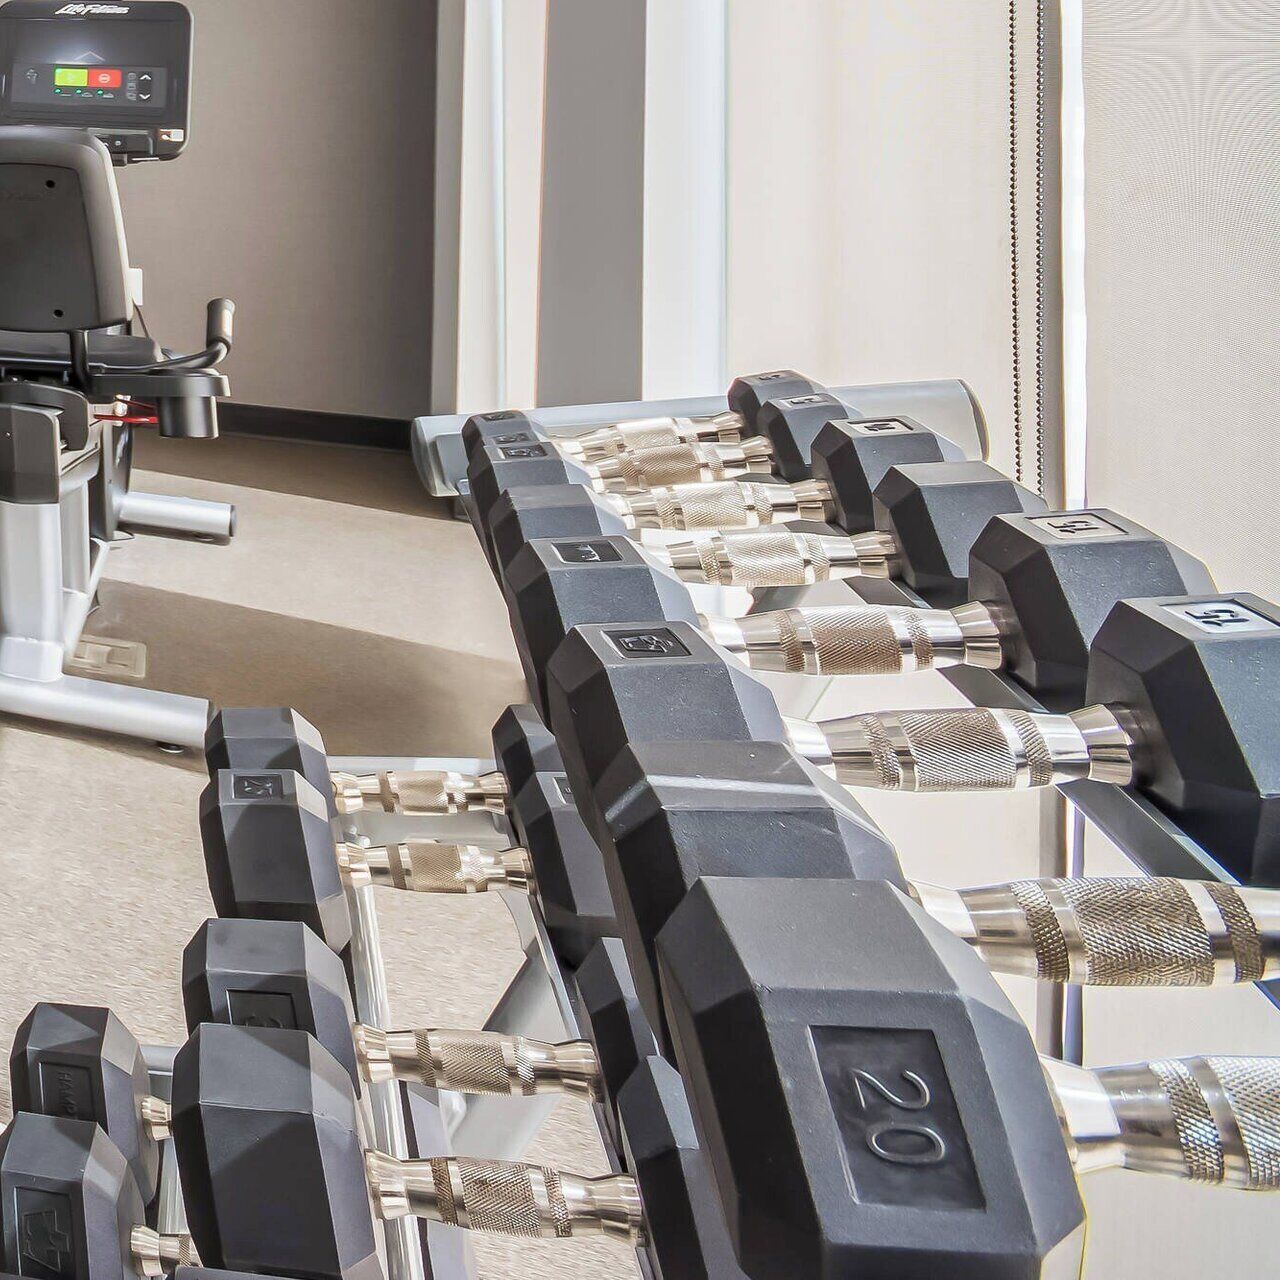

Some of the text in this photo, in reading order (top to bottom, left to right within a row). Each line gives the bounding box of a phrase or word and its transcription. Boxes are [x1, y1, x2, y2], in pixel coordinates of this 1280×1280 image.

[1046, 519, 1101, 535] 15
[1183, 607, 1251, 628] 15
[847, 1066, 948, 1165] 20
